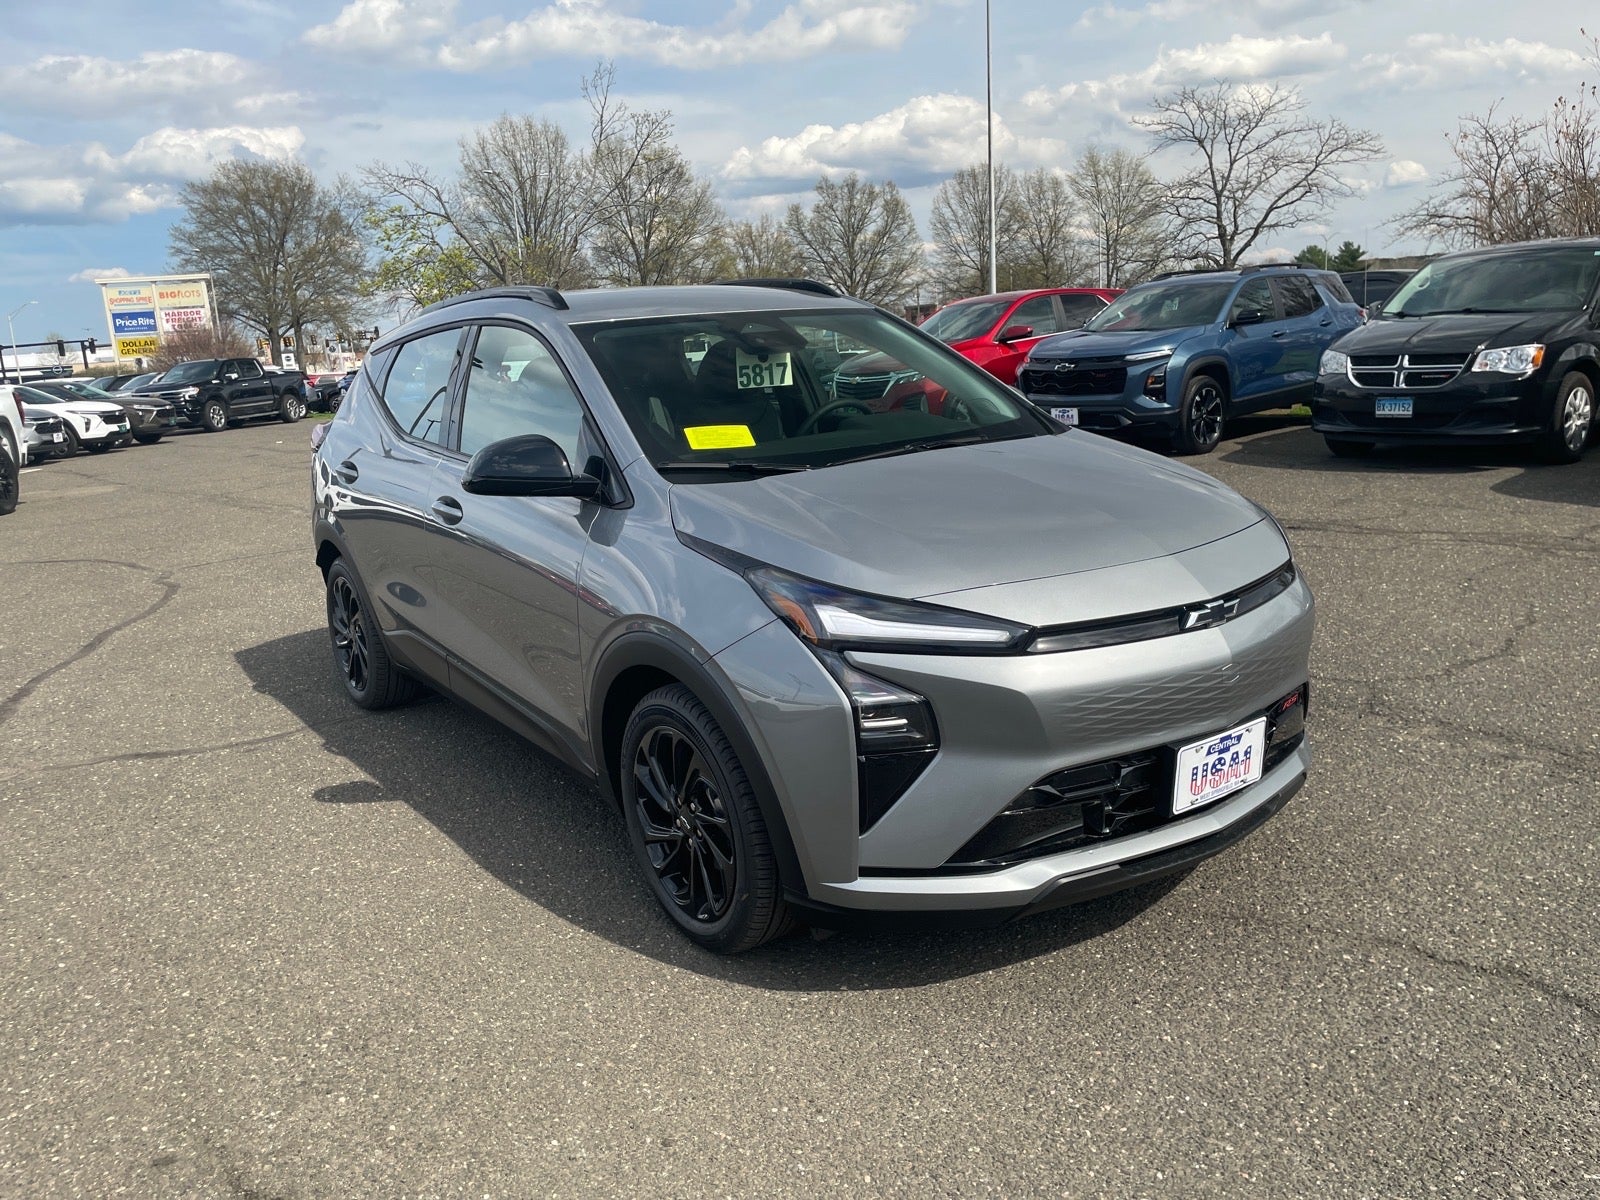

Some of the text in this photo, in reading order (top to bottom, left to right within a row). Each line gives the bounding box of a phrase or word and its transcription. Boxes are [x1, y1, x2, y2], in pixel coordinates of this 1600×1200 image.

[122, 340, 156, 348] DOLLAR
[738, 362, 788, 388] 5817
[1210, 737, 1239, 753] CENTRAL
